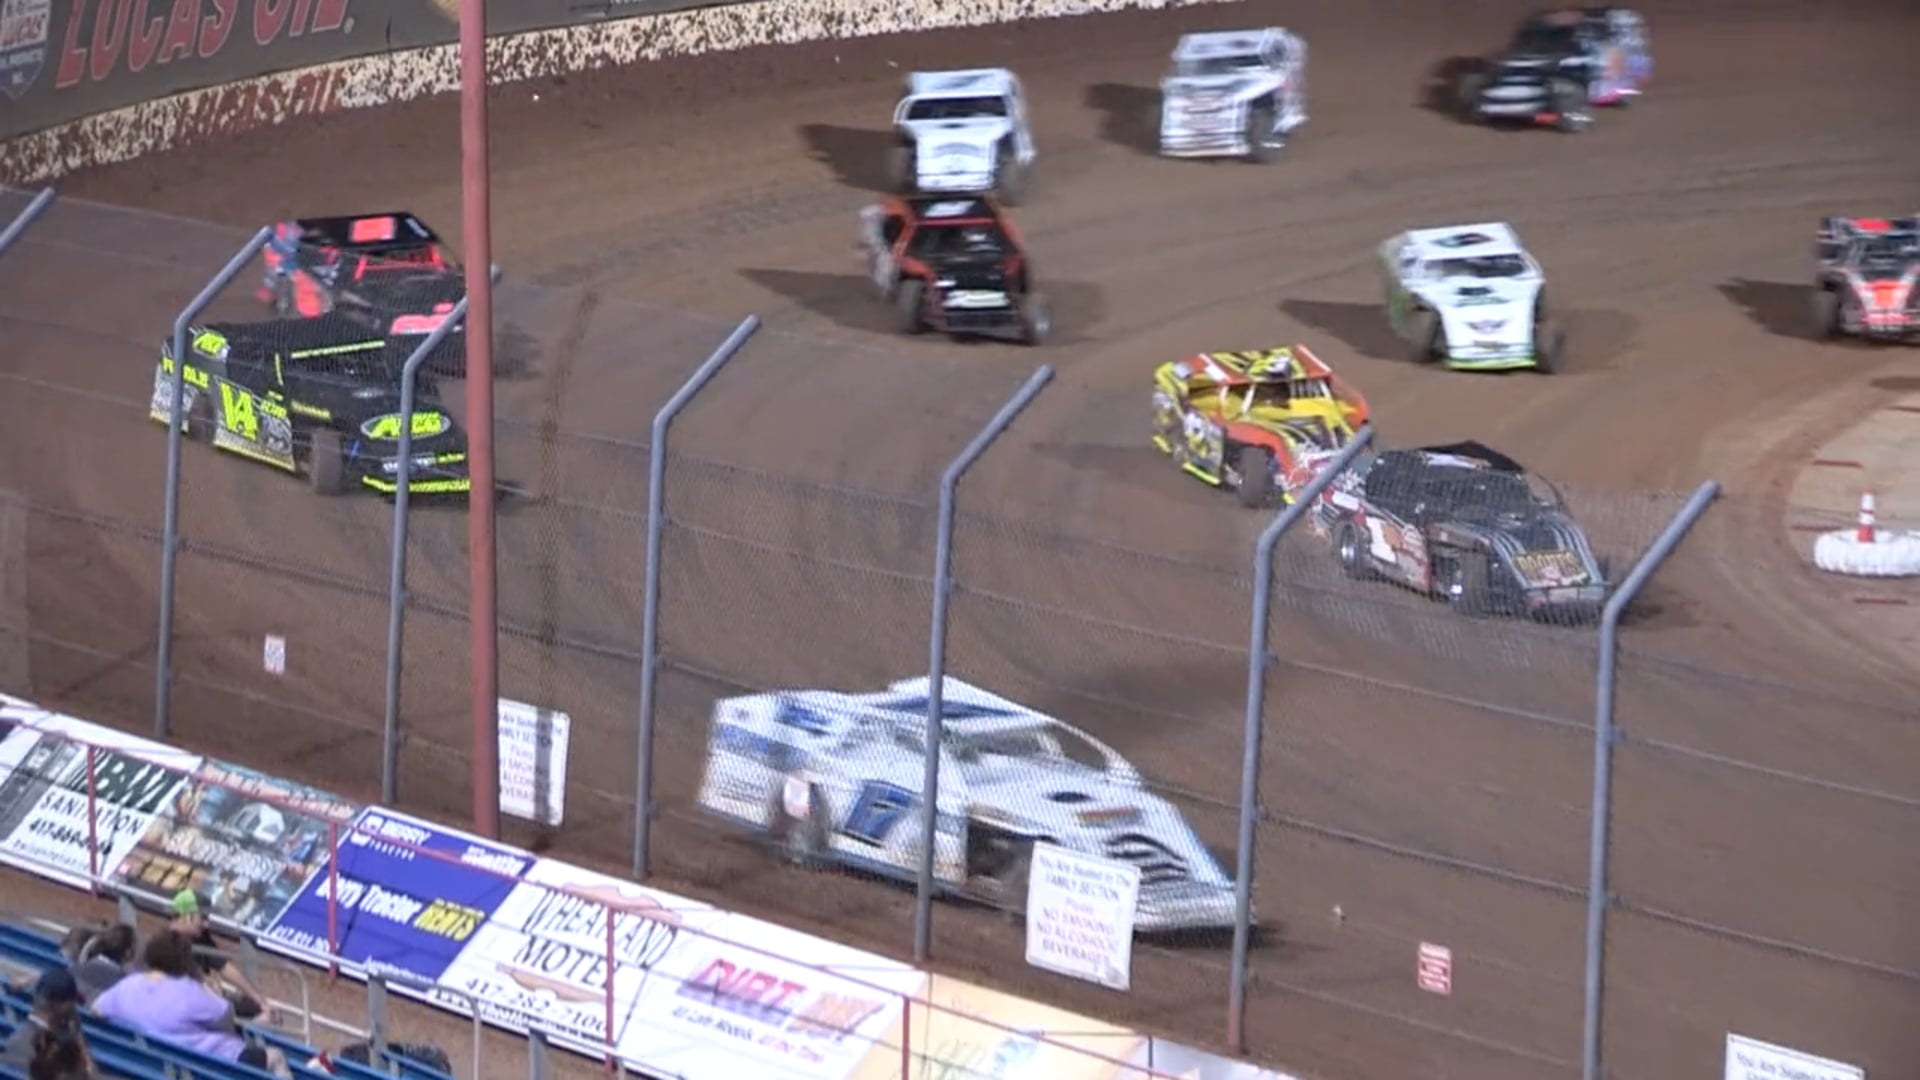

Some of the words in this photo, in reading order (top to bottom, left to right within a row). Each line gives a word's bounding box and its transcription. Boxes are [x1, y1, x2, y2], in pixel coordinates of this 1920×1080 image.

[54, 0, 240, 89] LUCAS
[40, 790, 146, 836] SANIATION
[520, 887, 679, 973] WHEAAND
